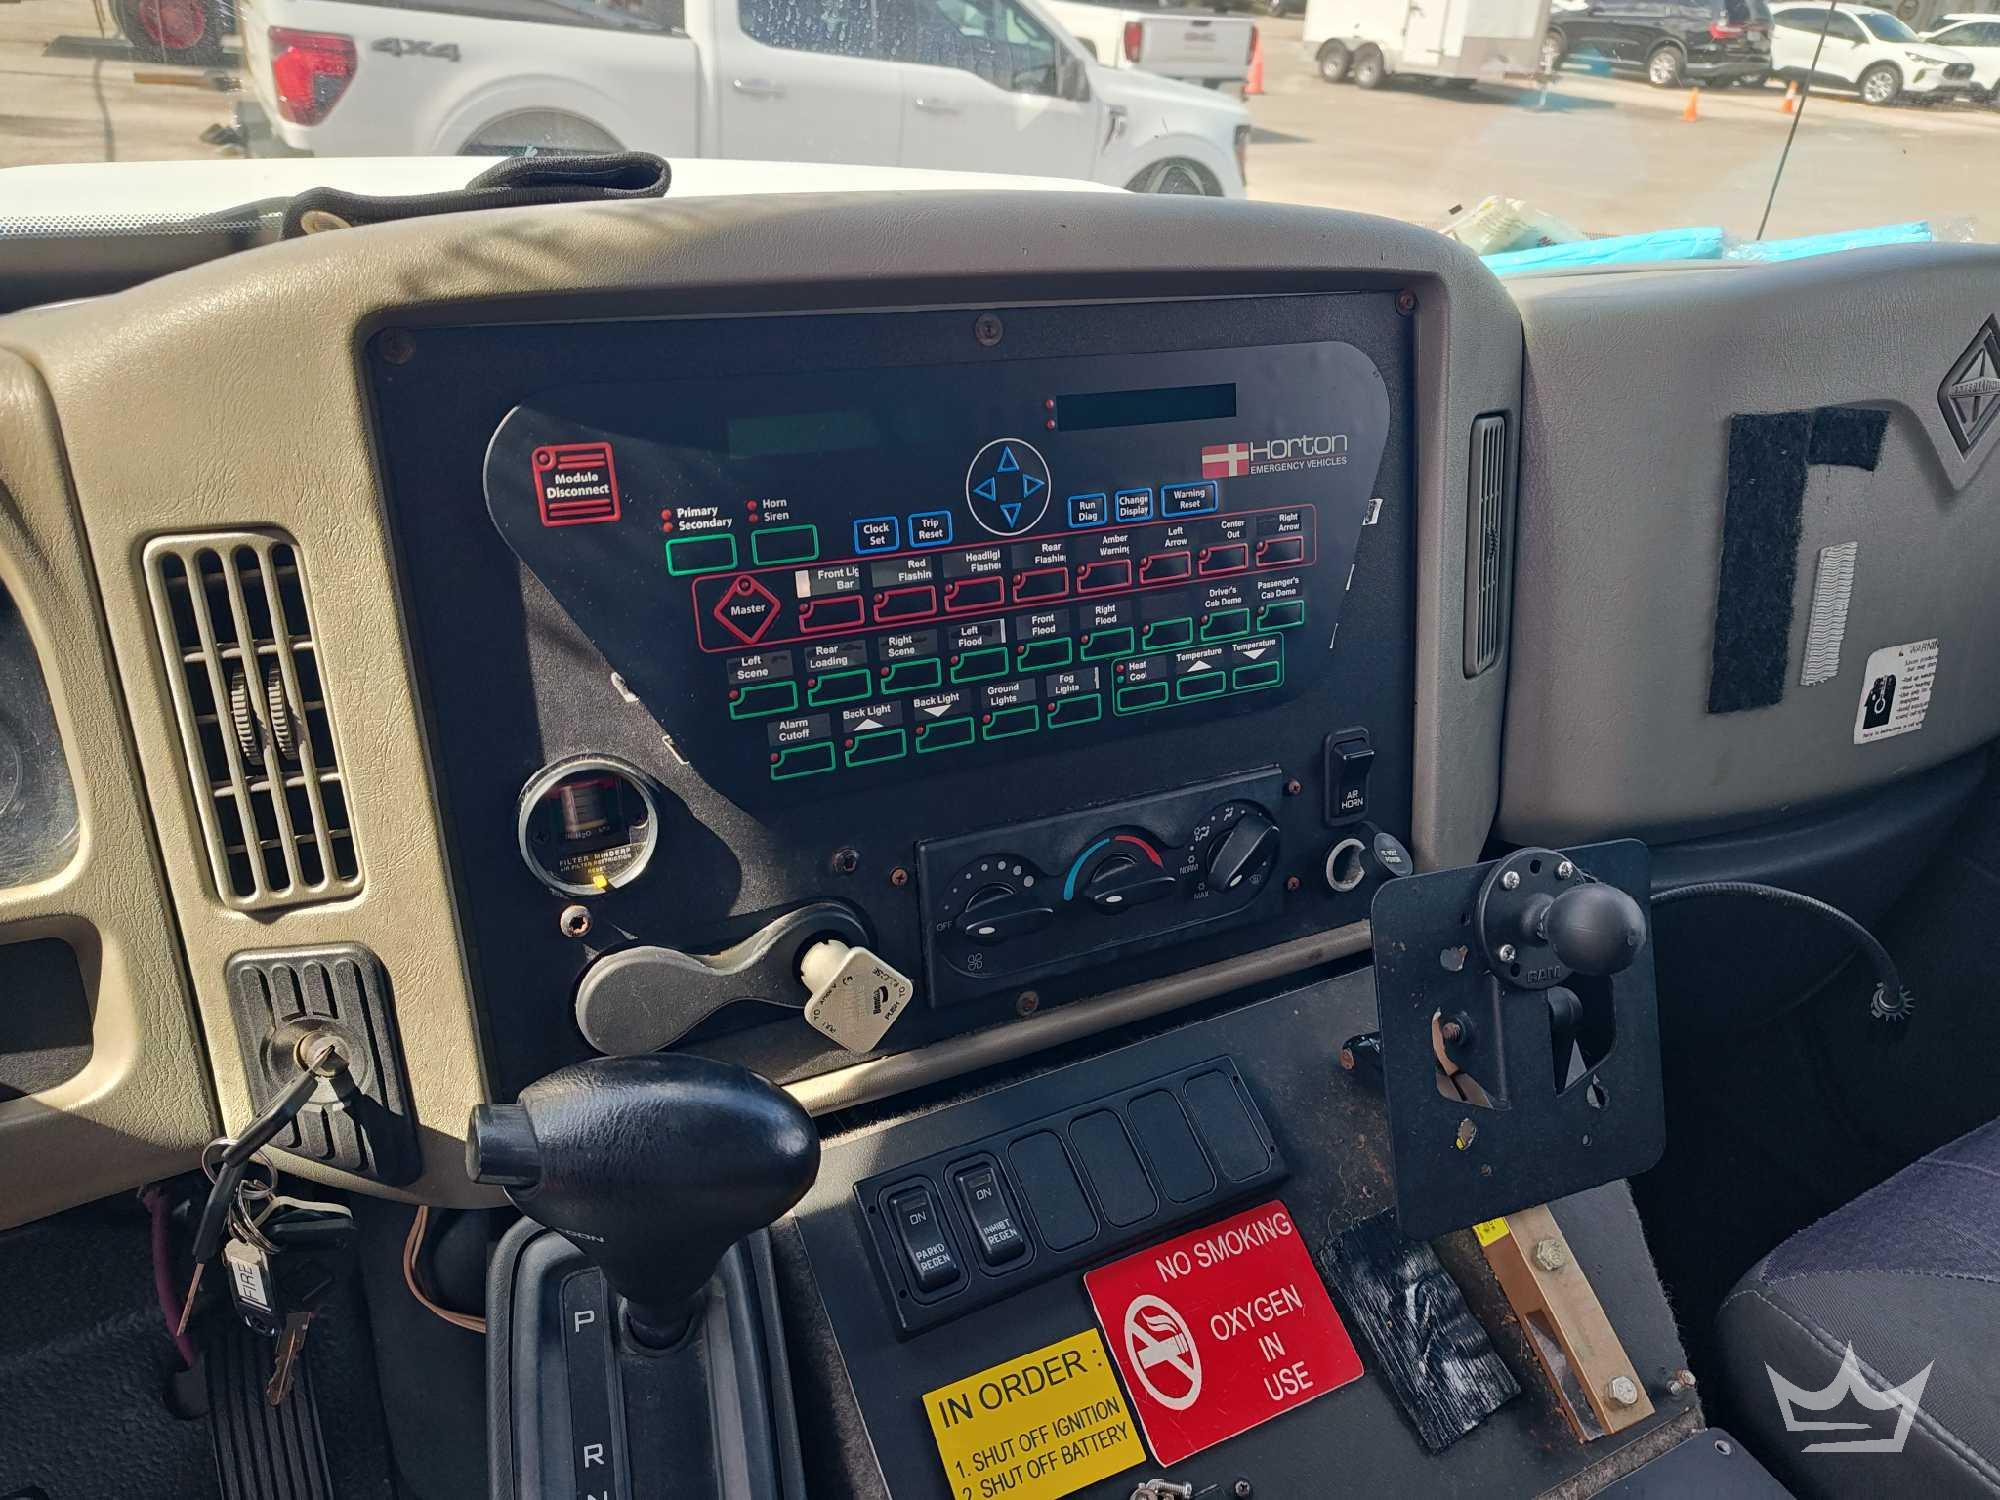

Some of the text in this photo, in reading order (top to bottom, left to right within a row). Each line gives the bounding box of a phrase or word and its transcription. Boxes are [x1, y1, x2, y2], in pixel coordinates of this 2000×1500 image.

[1250, 434, 1348, 461] Horton
[1250, 456, 1348, 475] EMERGENCY VEHICLES
[555, 471, 599, 485] Module
[546, 483, 610, 499] Disconnect
[1173, 489, 1206, 500] Warning
[763, 498, 787, 509] Horn
[1079, 501, 1096, 510] Run
[1179, 500, 1201, 510] Reset
[677, 506, 718, 519] Primary
[764, 511, 790, 522] Siren
[1078, 512, 1098, 522] Diag
[1279, 513, 1298, 522] Right
[678, 517, 733, 531] Secondary
[863, 523, 890, 535] Clock
[921, 519, 939, 529] Trip
[1221, 520, 1246, 529] Center
[1278, 523, 1300, 532] Arrow
[918, 528, 943, 540] Reset
[1167, 527, 1183, 536] Left
[1227, 530, 1241, 539] Out
[870, 534, 885, 546] Set
[1102, 534, 1128, 545] Amber
[1164, 538, 1188, 548] Arrow
[1041, 543, 1062, 553] Rear
[907, 558, 926, 569] Red
[817, 568, 845, 580] Front
[836, 580, 855, 590] Bar
[730, 603, 766, 616] Master
[1095, 604, 1116, 615] Right
[1031, 613, 1055, 625] Front
[1095, 614, 1117, 626] Flood
[961, 625, 979, 636] Left
[1032, 625, 1056, 637] Flood
[888, 635, 913, 647] Right
[958, 636, 983, 647] Flood
[1231, 638, 1276, 651] Temperature
[815, 645, 839, 656] Rear
[888, 647, 915, 657] Scene
[1176, 647, 1223, 662] Temperature
[741, 655, 762, 668] Left
[810, 655, 848, 669] Loading
[737, 668, 769, 680] Scene
[1059, 674, 1075, 684] Fog
[987, 684, 1020, 695] Ground
[1055, 684, 1080, 695] Lights
[913, 692, 960, 708] Back Light
[990, 695, 1018, 706] Lights
[843, 703, 892, 720] Back Light
[779, 719, 809, 730] Alarm
[779, 729, 810, 742] Cutoff
[1341, 797, 1364, 809] HORN
[560, 855, 589, 866] FILTER
[936, 920, 953, 931] OFF
[976, 1187, 992, 1201] ON
[909, 1211, 927, 1225] ON
[987, 1228, 1018, 1245] REGEN
[1155, 1212, 1293, 1283] NO SMOKING
[920, 1254, 951, 1272] REGEN
[237, 1262, 260, 1301] FIRE
[1210, 1284, 1304, 1341] OXYGEN
[574, 1310, 595, 1333] P
[1258, 1332, 1286, 1362] IN
[1264, 1360, 1314, 1401] USE
[938, 1393, 974, 1428] IN
[978, 1350, 1088, 1410] ORDER
[955, 1396, 1121, 1479] 1. SHUT OFF IGNITION
[583, 1443, 605, 1468] R
[980, 1465, 1024, 1499] SHUT
[1026, 1454, 1058, 1479] OFF
[1062, 1421, 1130, 1465] BATTERY
